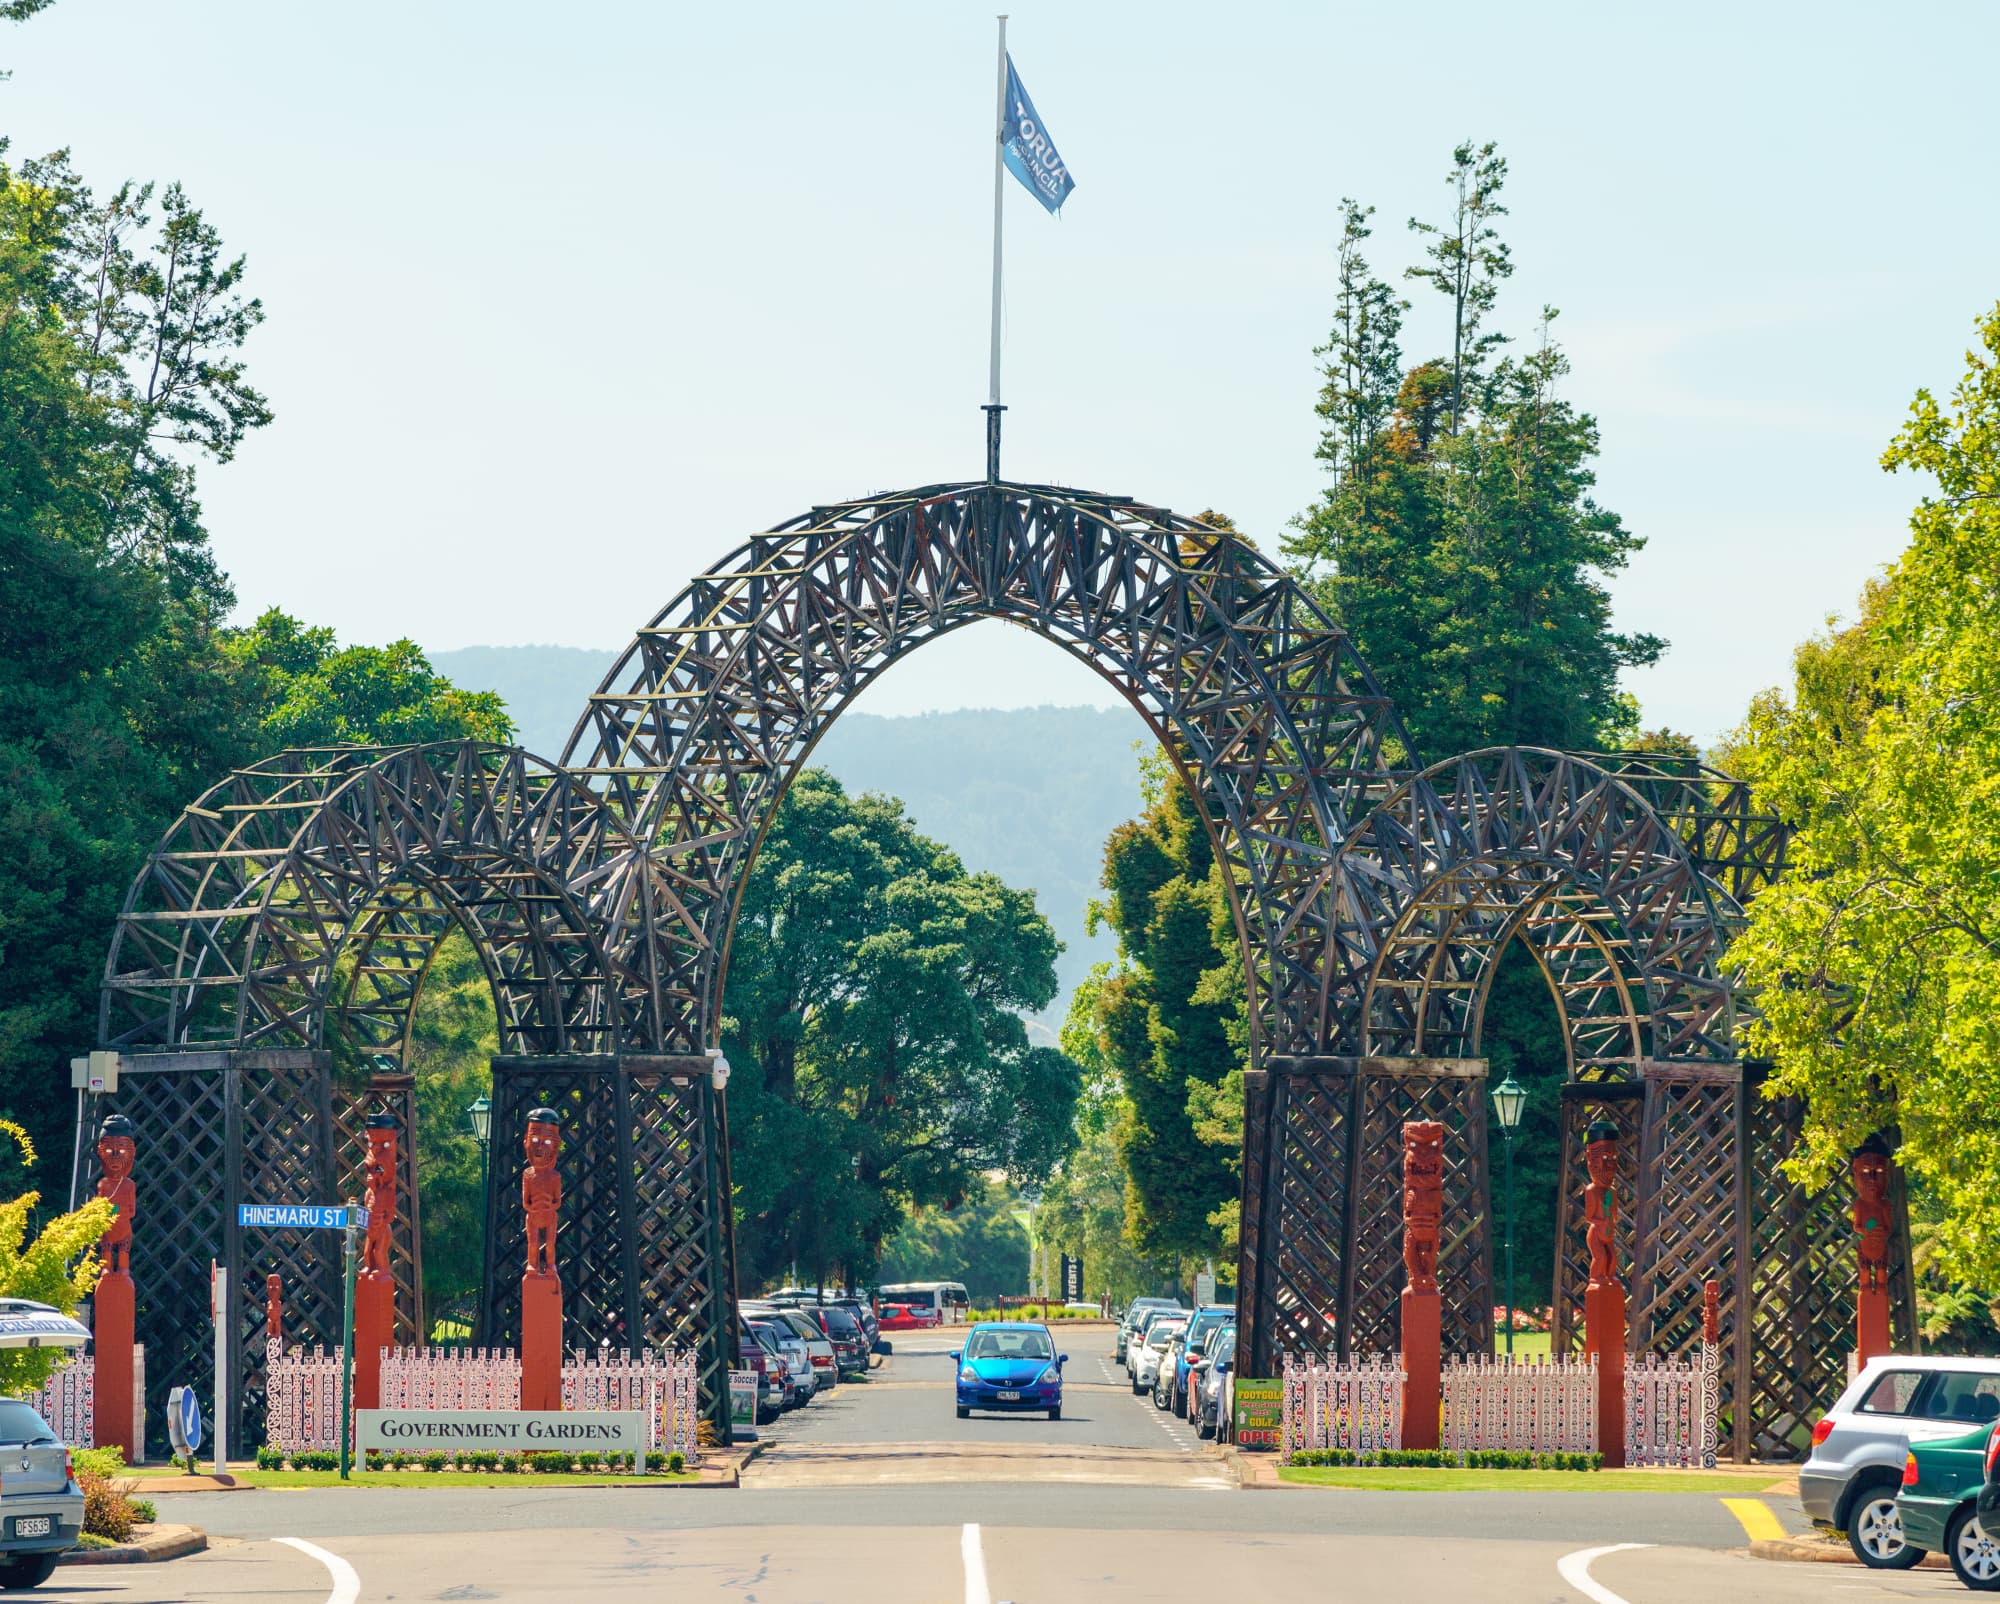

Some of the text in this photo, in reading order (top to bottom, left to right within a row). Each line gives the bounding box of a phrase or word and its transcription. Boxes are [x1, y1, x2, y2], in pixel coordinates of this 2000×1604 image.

[243, 1207, 319, 1225] HINEMARU
[323, 1209, 343, 1226] ST
[733, 1375, 757, 1385] SOCCER
[1249, 1417, 1274, 1428] GOLF
[17, 1519, 49, 1535] DFS635
